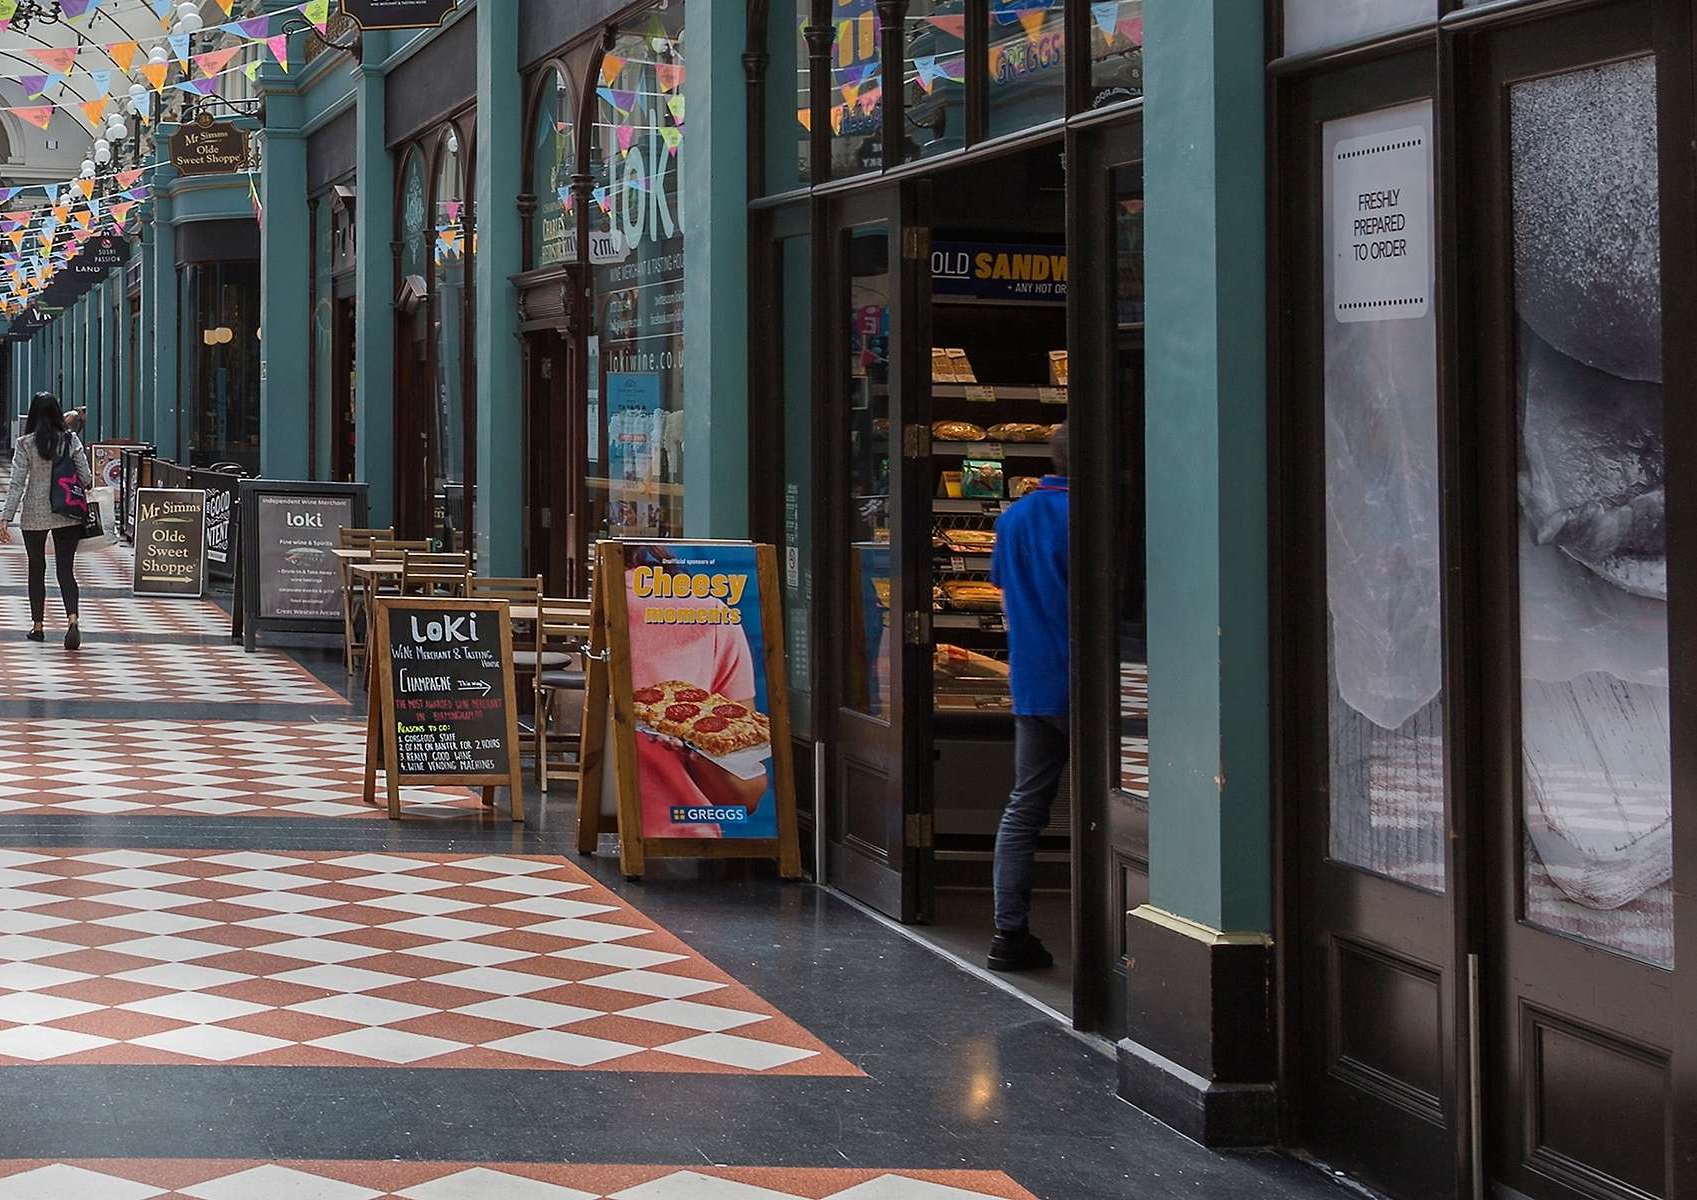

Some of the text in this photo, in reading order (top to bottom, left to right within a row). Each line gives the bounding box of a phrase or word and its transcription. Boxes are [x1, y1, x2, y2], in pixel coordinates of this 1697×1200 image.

[185, 131, 228, 147] Mr Simms
[196, 145, 219, 155] Olde
[177, 156, 204, 166] Sweet
[1358, 189, 1400, 211] FRESHLY
[1353, 214, 1406, 237] PREPARED
[1353, 239, 1407, 262] TO ORDER
[930, 251, 1068, 282] OLD SANDW
[1015, 283, 1032, 293] ANY
[1035, 283, 1052, 294] HOT
[609, 349, 684, 372] lokiwine.co.u
[140, 501, 201, 522] Mr Simms
[210, 491, 231, 517] GOOD
[287, 511, 323, 527] loki
[152, 530, 186, 543] Olde
[206, 520, 229, 547] NTENT
[147, 545, 189, 558] Sweet
[633, 566, 748, 605] Cheesy
[645, 607, 742, 625] moments
[453, 647, 462, 660] &
[460, 741, 473, 750] FOR
[432, 751, 450, 761] GOOD
[454, 750, 472, 761] WINE
[460, 759, 495, 770] MACHINES
[688, 808, 744, 821] GREGGS
